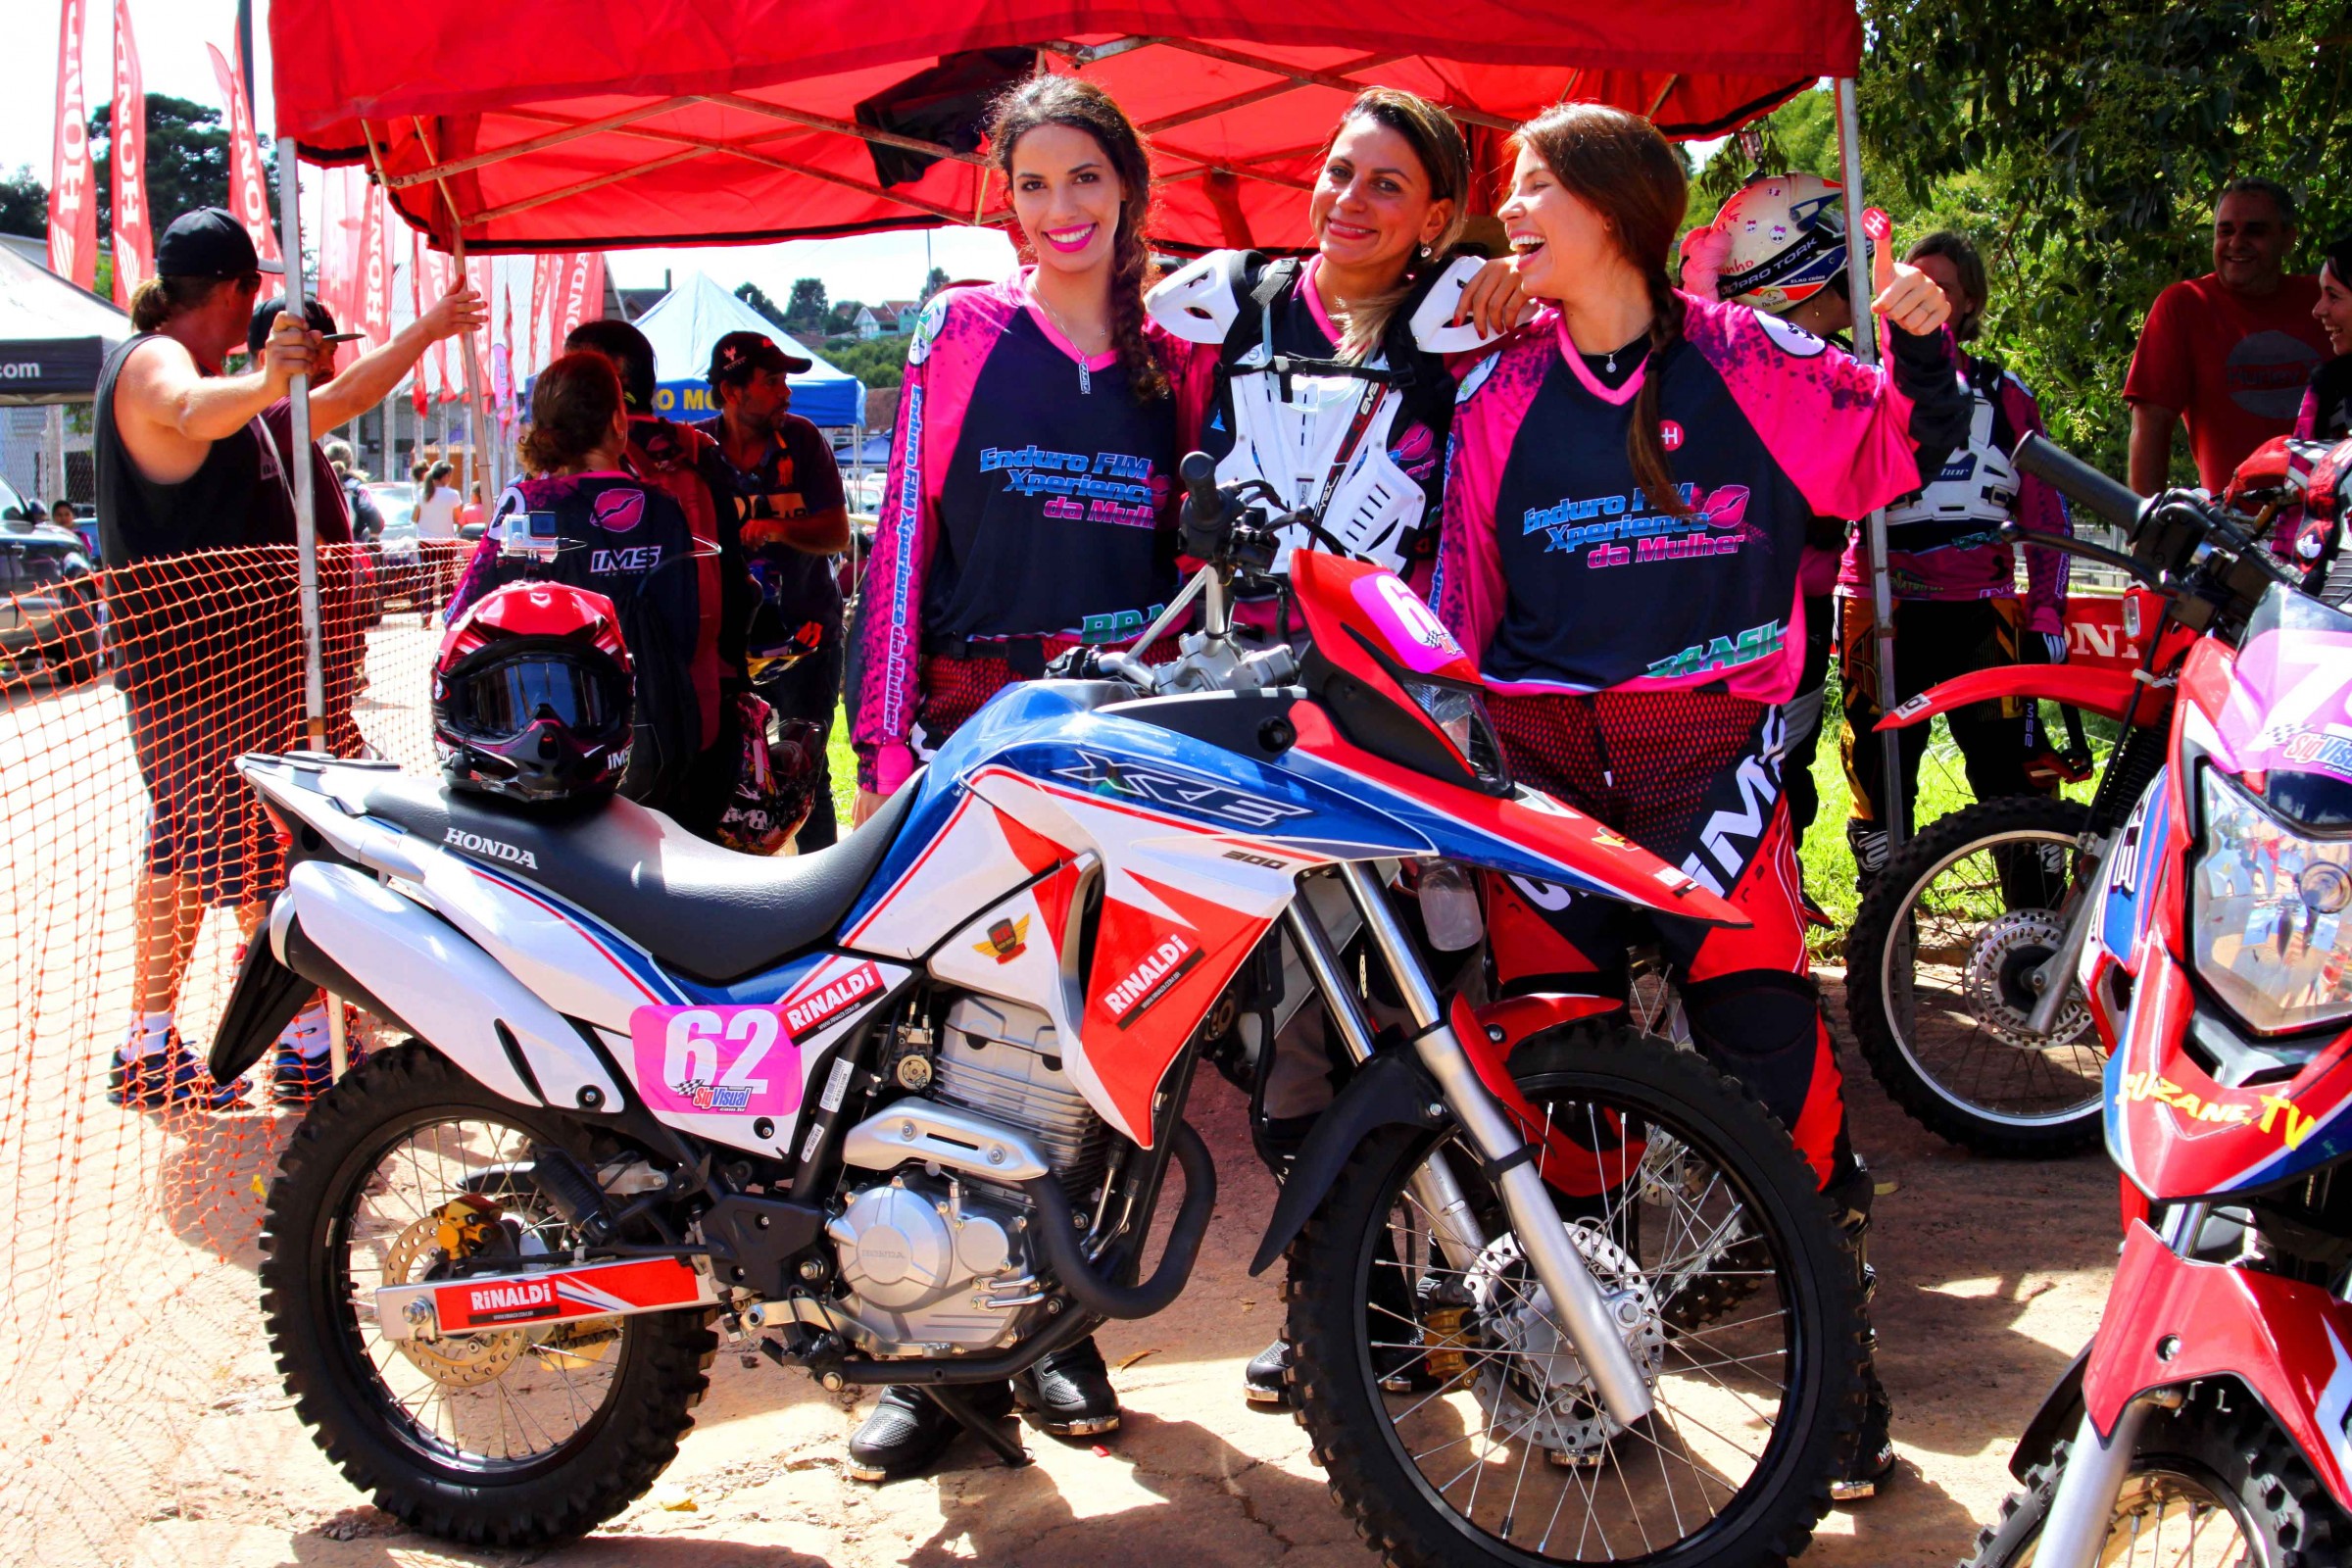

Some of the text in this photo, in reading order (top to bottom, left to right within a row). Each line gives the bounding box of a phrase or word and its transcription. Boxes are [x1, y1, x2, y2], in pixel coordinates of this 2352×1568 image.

[1739, 237, 1818, 289] PRO TORK
[564, 251, 591, 341] ONDA
[0, 363, 41, 379] om
[979, 445, 1153, 480] Enduro FIM
[1043, 496, 1084, 520] da
[1523, 494, 1627, 536] Enduro
[590, 545, 662, 573] IMS
[883, 383, 922, 737] Enduro FIM Xperience da Mulher
[1587, 532, 1746, 569] da Mulher
[1638, 617, 1784, 679] BRASIL
[1050, 749, 1315, 827] XRE
[443, 826, 539, 870] HONDA
[1221, 850, 1290, 871] 300
[662, 1007, 779, 1096] 62
[694, 1087, 752, 1109] SigVisual
